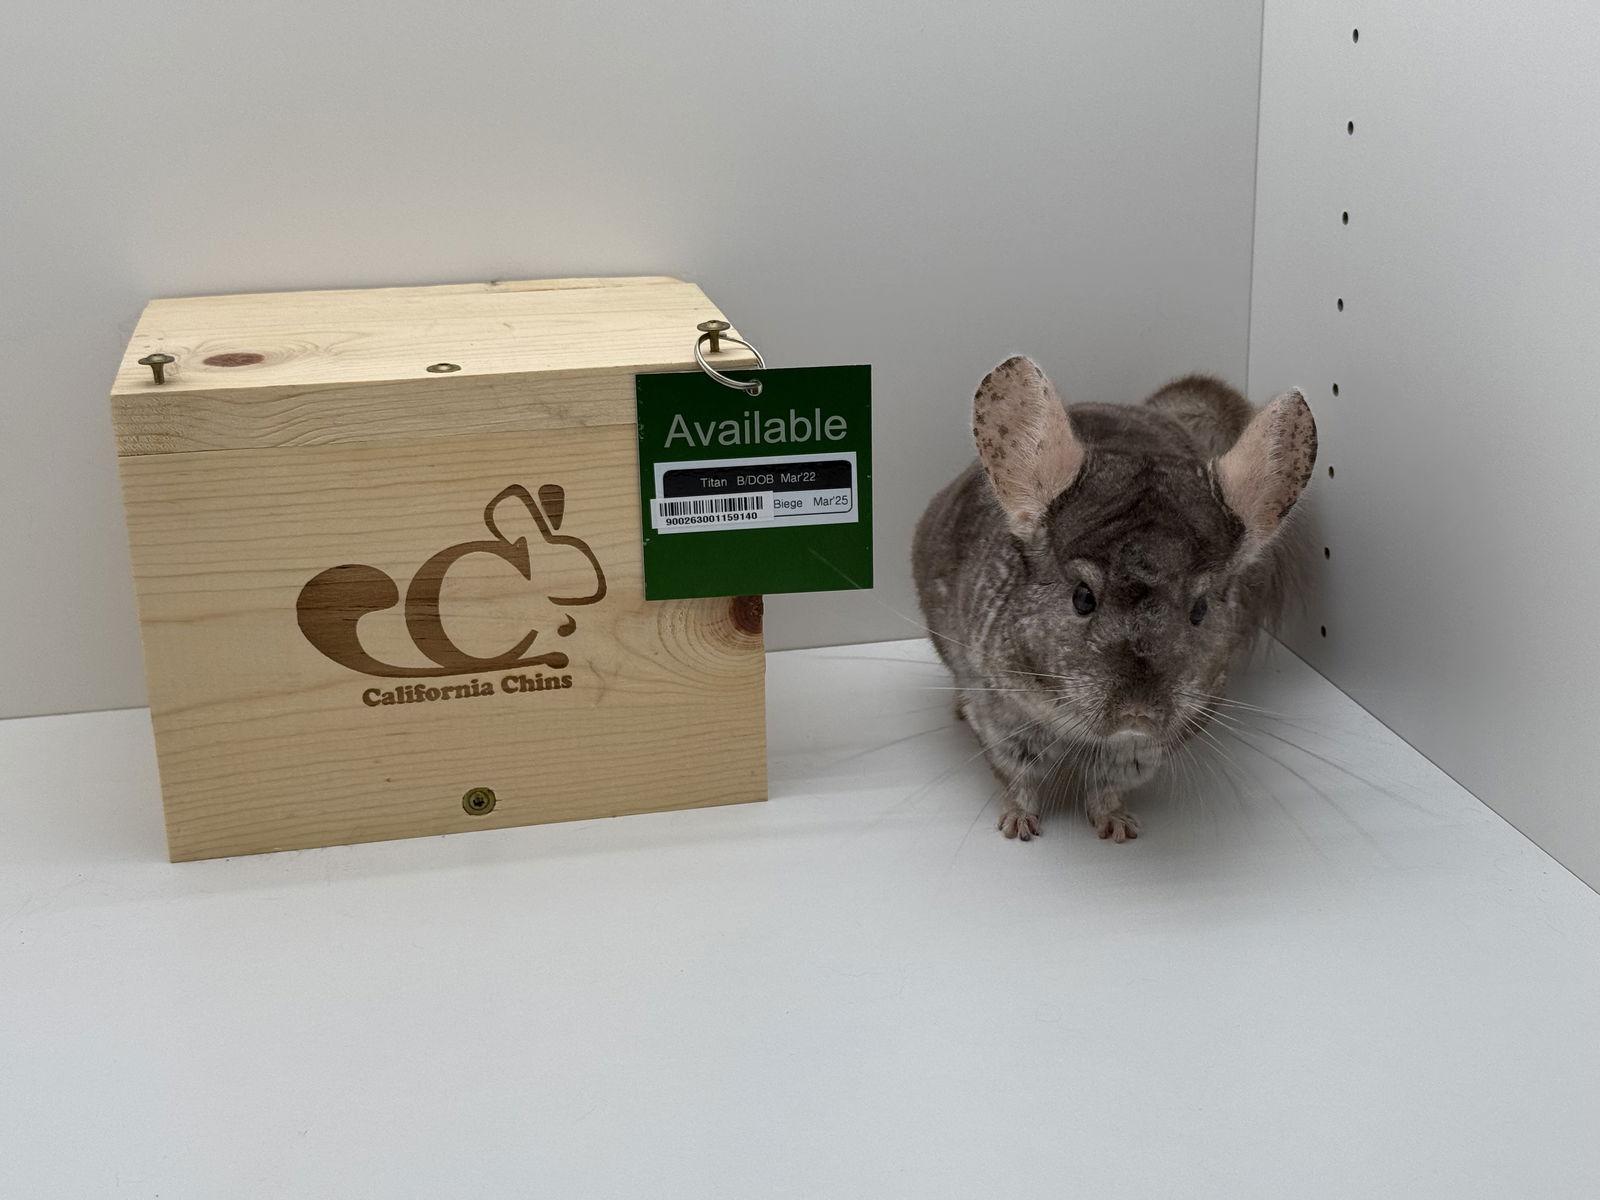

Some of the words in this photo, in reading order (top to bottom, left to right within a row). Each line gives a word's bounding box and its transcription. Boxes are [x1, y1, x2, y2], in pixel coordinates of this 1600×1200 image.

[664, 408, 848, 448] Available
[700, 477, 728, 488] Titan
[737, 474, 774, 486] B/DOB
[781, 471, 816, 483] Mar'22
[774, 499, 803, 510] Biege
[813, 495, 849, 507] Mar'25
[666, 512, 758, 526] 900263001159140
[362, 679, 495, 707] California
[501, 673, 573, 693] Chins
